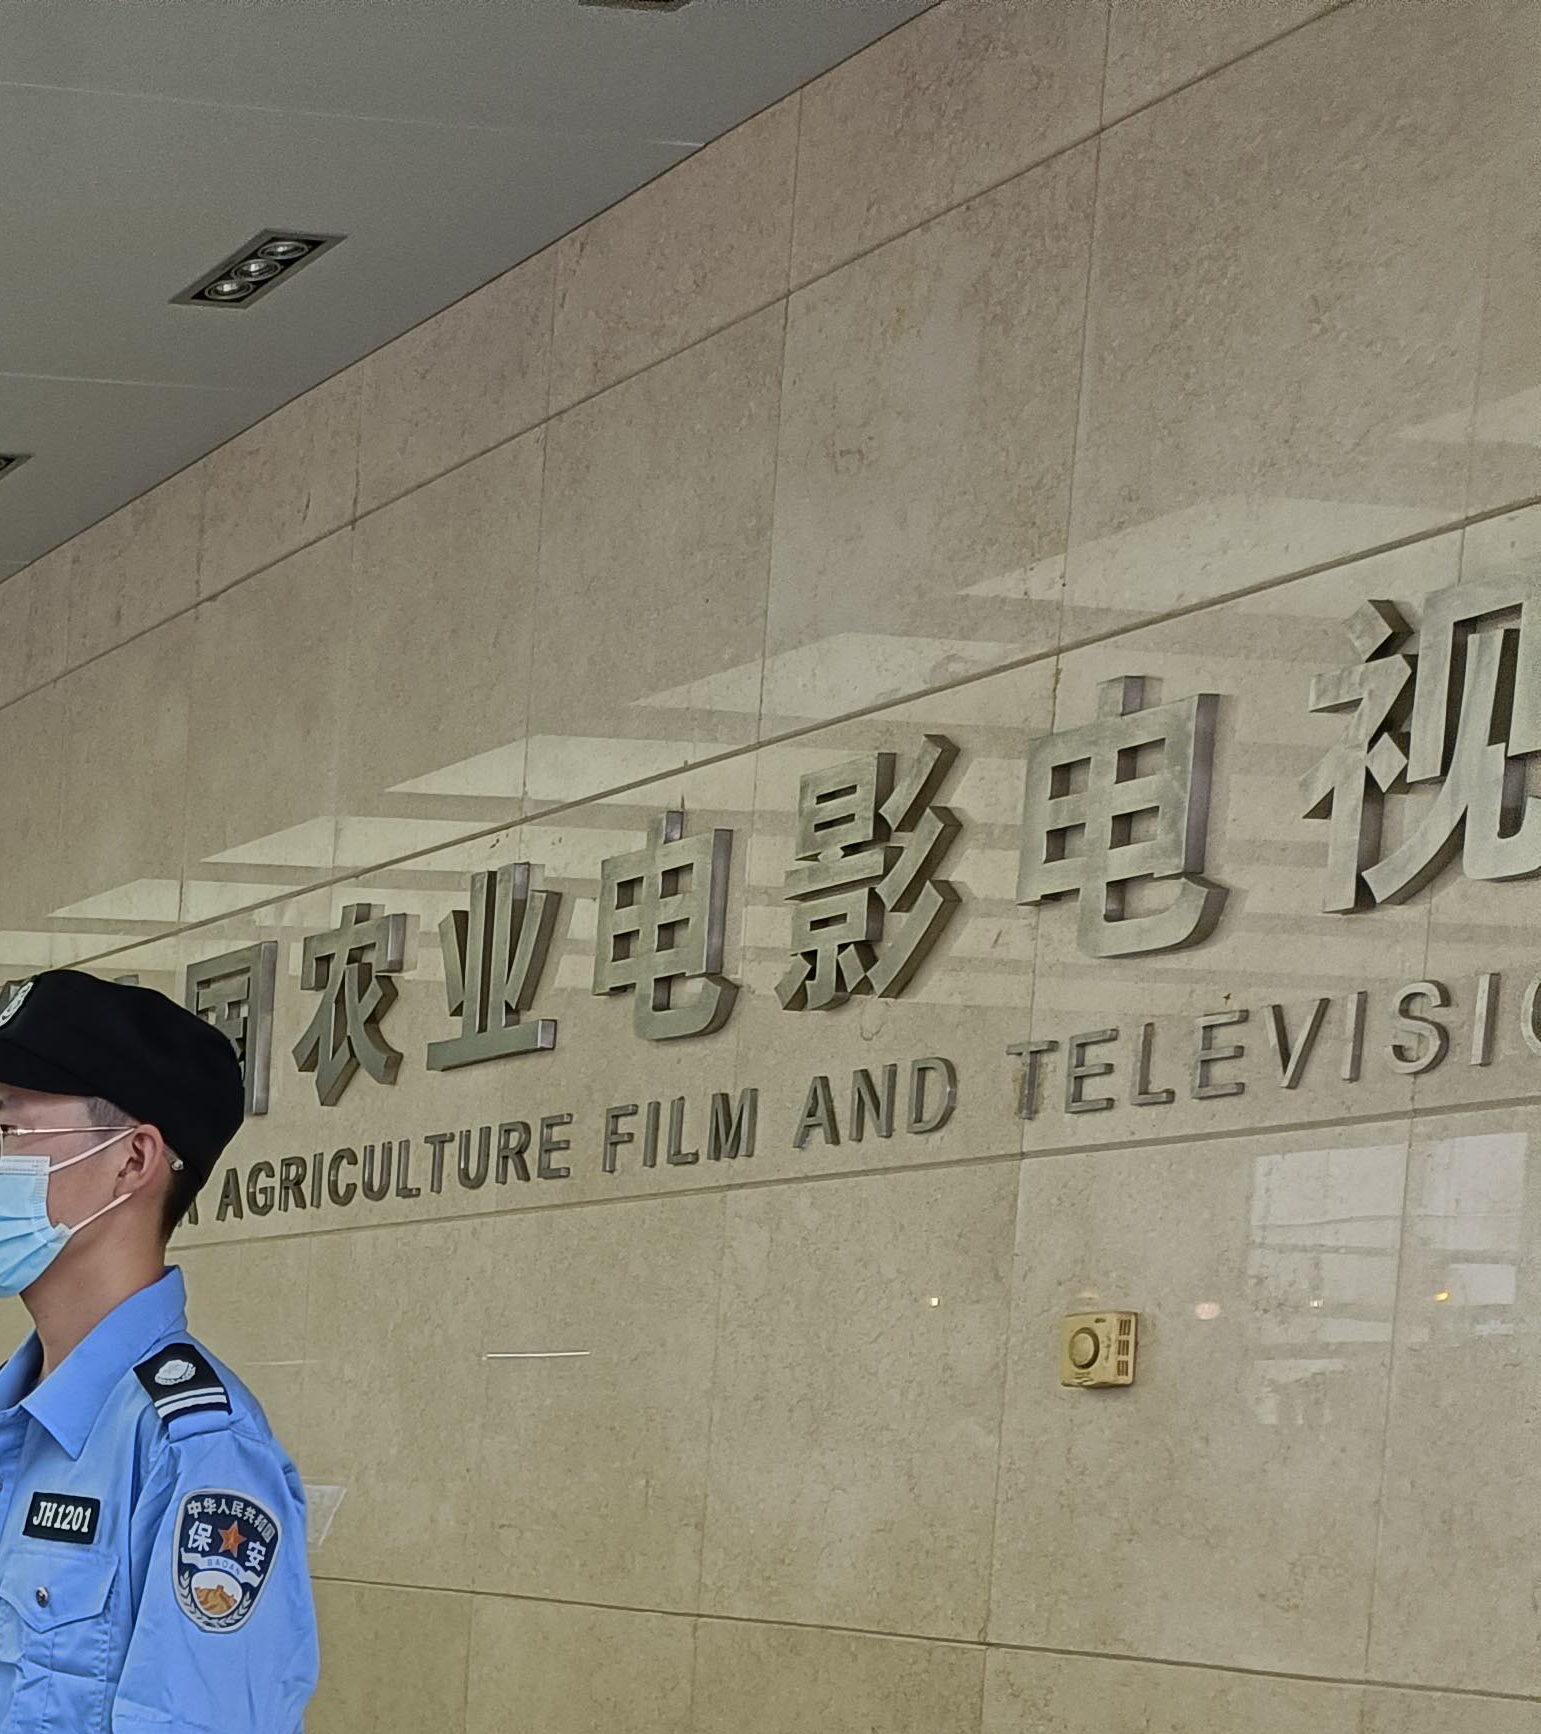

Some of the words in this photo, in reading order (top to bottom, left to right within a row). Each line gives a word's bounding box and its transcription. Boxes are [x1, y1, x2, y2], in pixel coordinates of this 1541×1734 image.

[113, 580, 1541, 1116] 国农业电影电视
[215, 1112, 573, 1222] AGRICULTURE
[601, 1087, 759, 1173] FILM
[793, 1056, 958, 1149] AND
[32, 1501, 92, 1533] JH1201
[187, 1497, 276, 1544] 中华人民共和国
[187, 1520, 213, 1552] 保
[245, 1541, 267, 1572] 安
